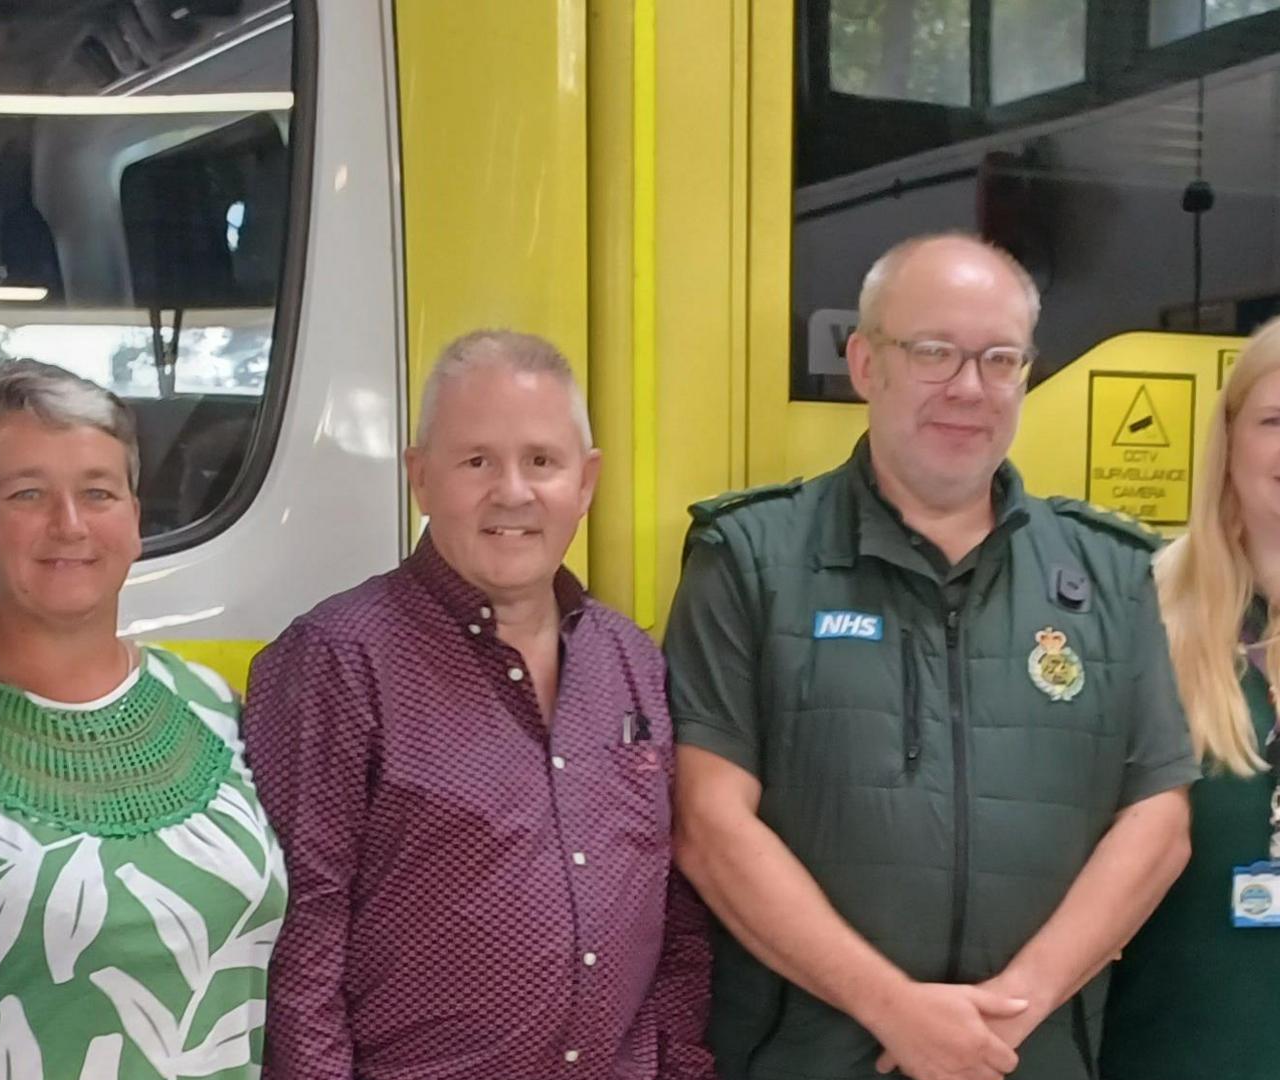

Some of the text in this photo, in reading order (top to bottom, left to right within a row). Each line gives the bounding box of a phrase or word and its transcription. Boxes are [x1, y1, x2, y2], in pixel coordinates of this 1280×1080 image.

[1123, 450, 1159, 463] CCTV
[1112, 486, 1166, 499] CAMERA
[819, 613, 878, 636] NHS
